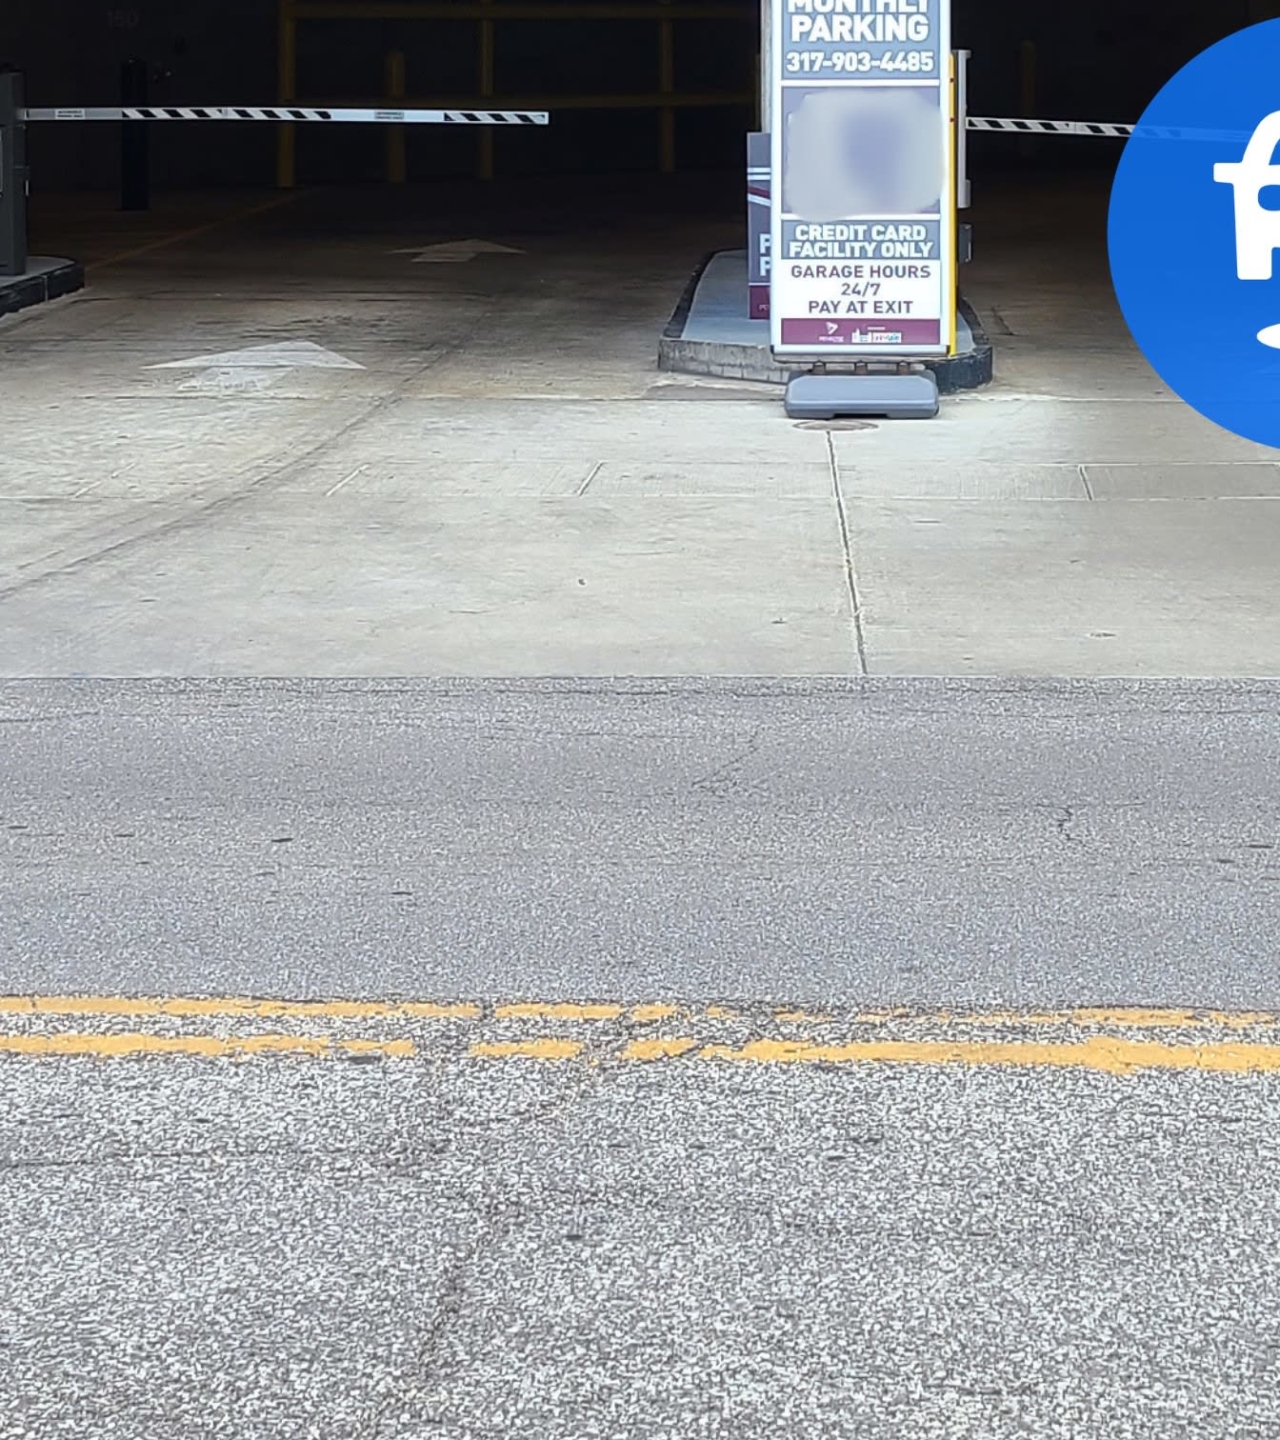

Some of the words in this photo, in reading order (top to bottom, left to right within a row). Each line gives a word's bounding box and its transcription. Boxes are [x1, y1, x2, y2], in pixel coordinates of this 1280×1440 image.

[790, 14, 929, 42] PARKING
[786, 51, 934, 72] 317-903-4485
[795, 225, 868, 241] CREDIT
[871, 225, 927, 241] CARD
[789, 241, 878, 258] FACILITY
[881, 241, 933, 258] ONLY
[791, 265, 864, 278] GARAGE
[870, 265, 931, 278] HOURS
[841, 283, 881, 297] 24/7
[808, 301, 841, 314] PAY
[846, 301, 868, 314] AT
[873, 301, 913, 314] EXIT
